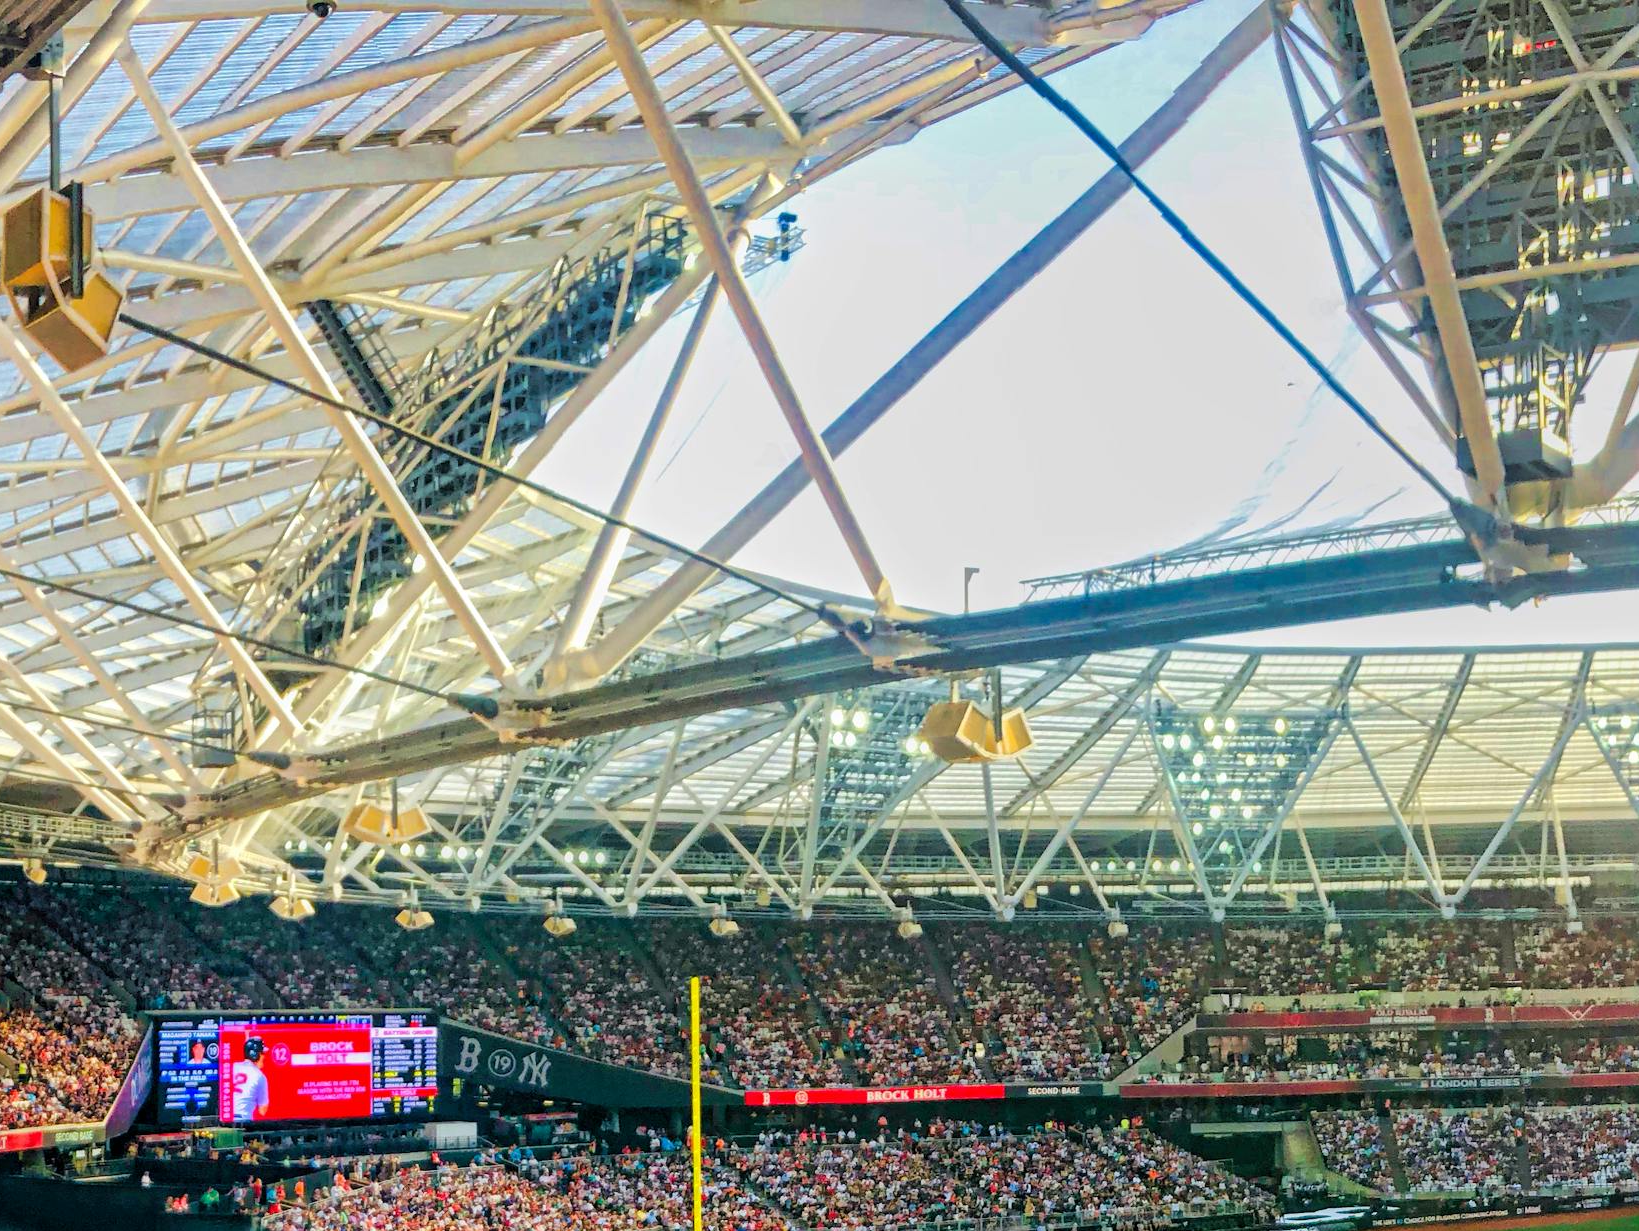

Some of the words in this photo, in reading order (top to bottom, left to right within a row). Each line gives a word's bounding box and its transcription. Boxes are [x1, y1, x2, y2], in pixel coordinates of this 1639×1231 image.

[310, 1041, 354, 1051] BROCK
[274, 1047, 287, 1061] 12
[316, 1054, 347, 1063] HOLT
[454, 1036, 482, 1073] B
[494, 1055, 511, 1071] 19
[518, 1051, 552, 1088] NY
[1431, 1080, 1477, 1088] LONDON
[1480, 1078, 1520, 1087] SERIES
[866, 1090, 909, 1102] BROCK
[914, 1088, 947, 1100] HOLT
[1027, 1087, 1058, 1096] SECOND
[1061, 1086, 1080, 1095] BASE
